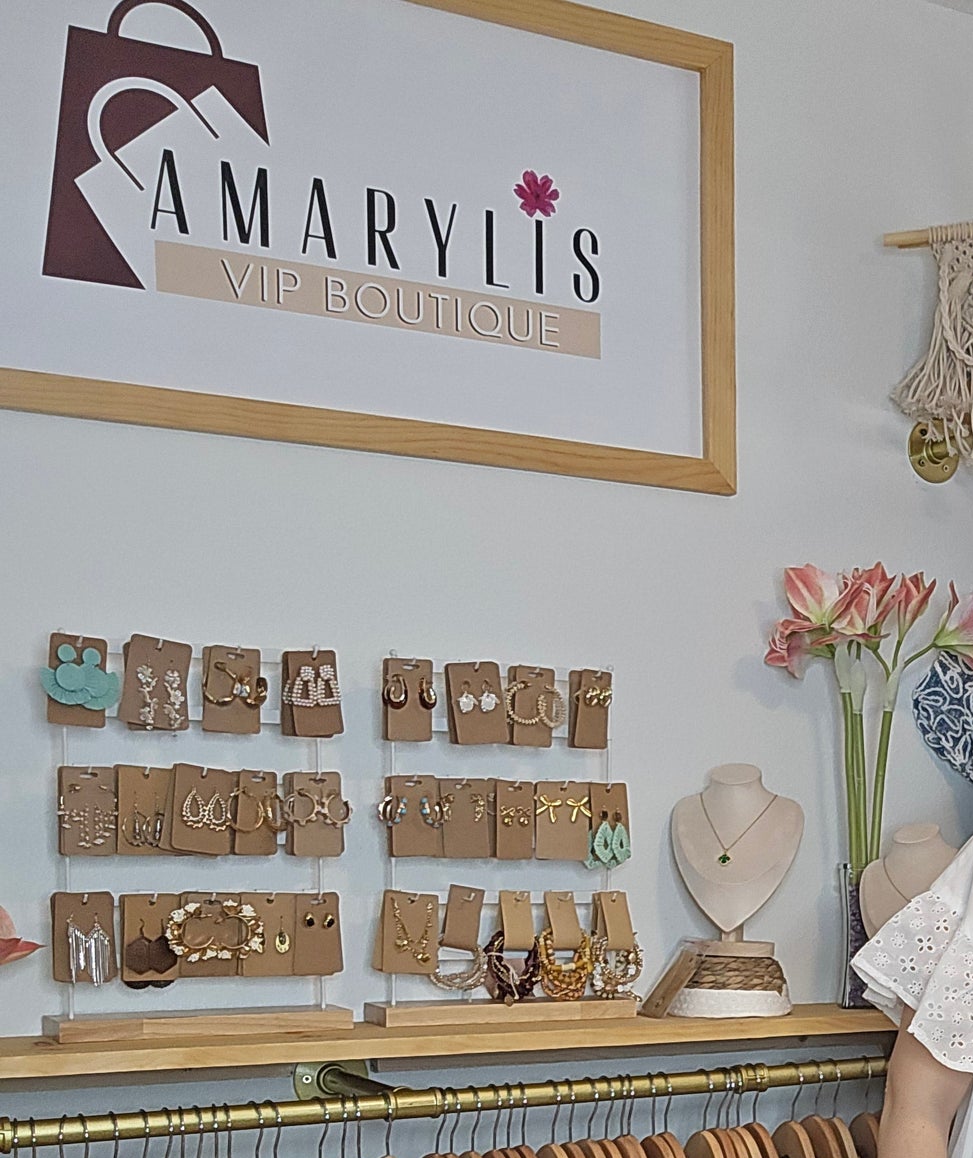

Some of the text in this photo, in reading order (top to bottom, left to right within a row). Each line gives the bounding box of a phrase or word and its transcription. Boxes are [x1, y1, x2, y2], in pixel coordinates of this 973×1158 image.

[150, 148, 600, 304] AMARYLIS
[220, 258, 560, 348] VIP BOUTIQUE
